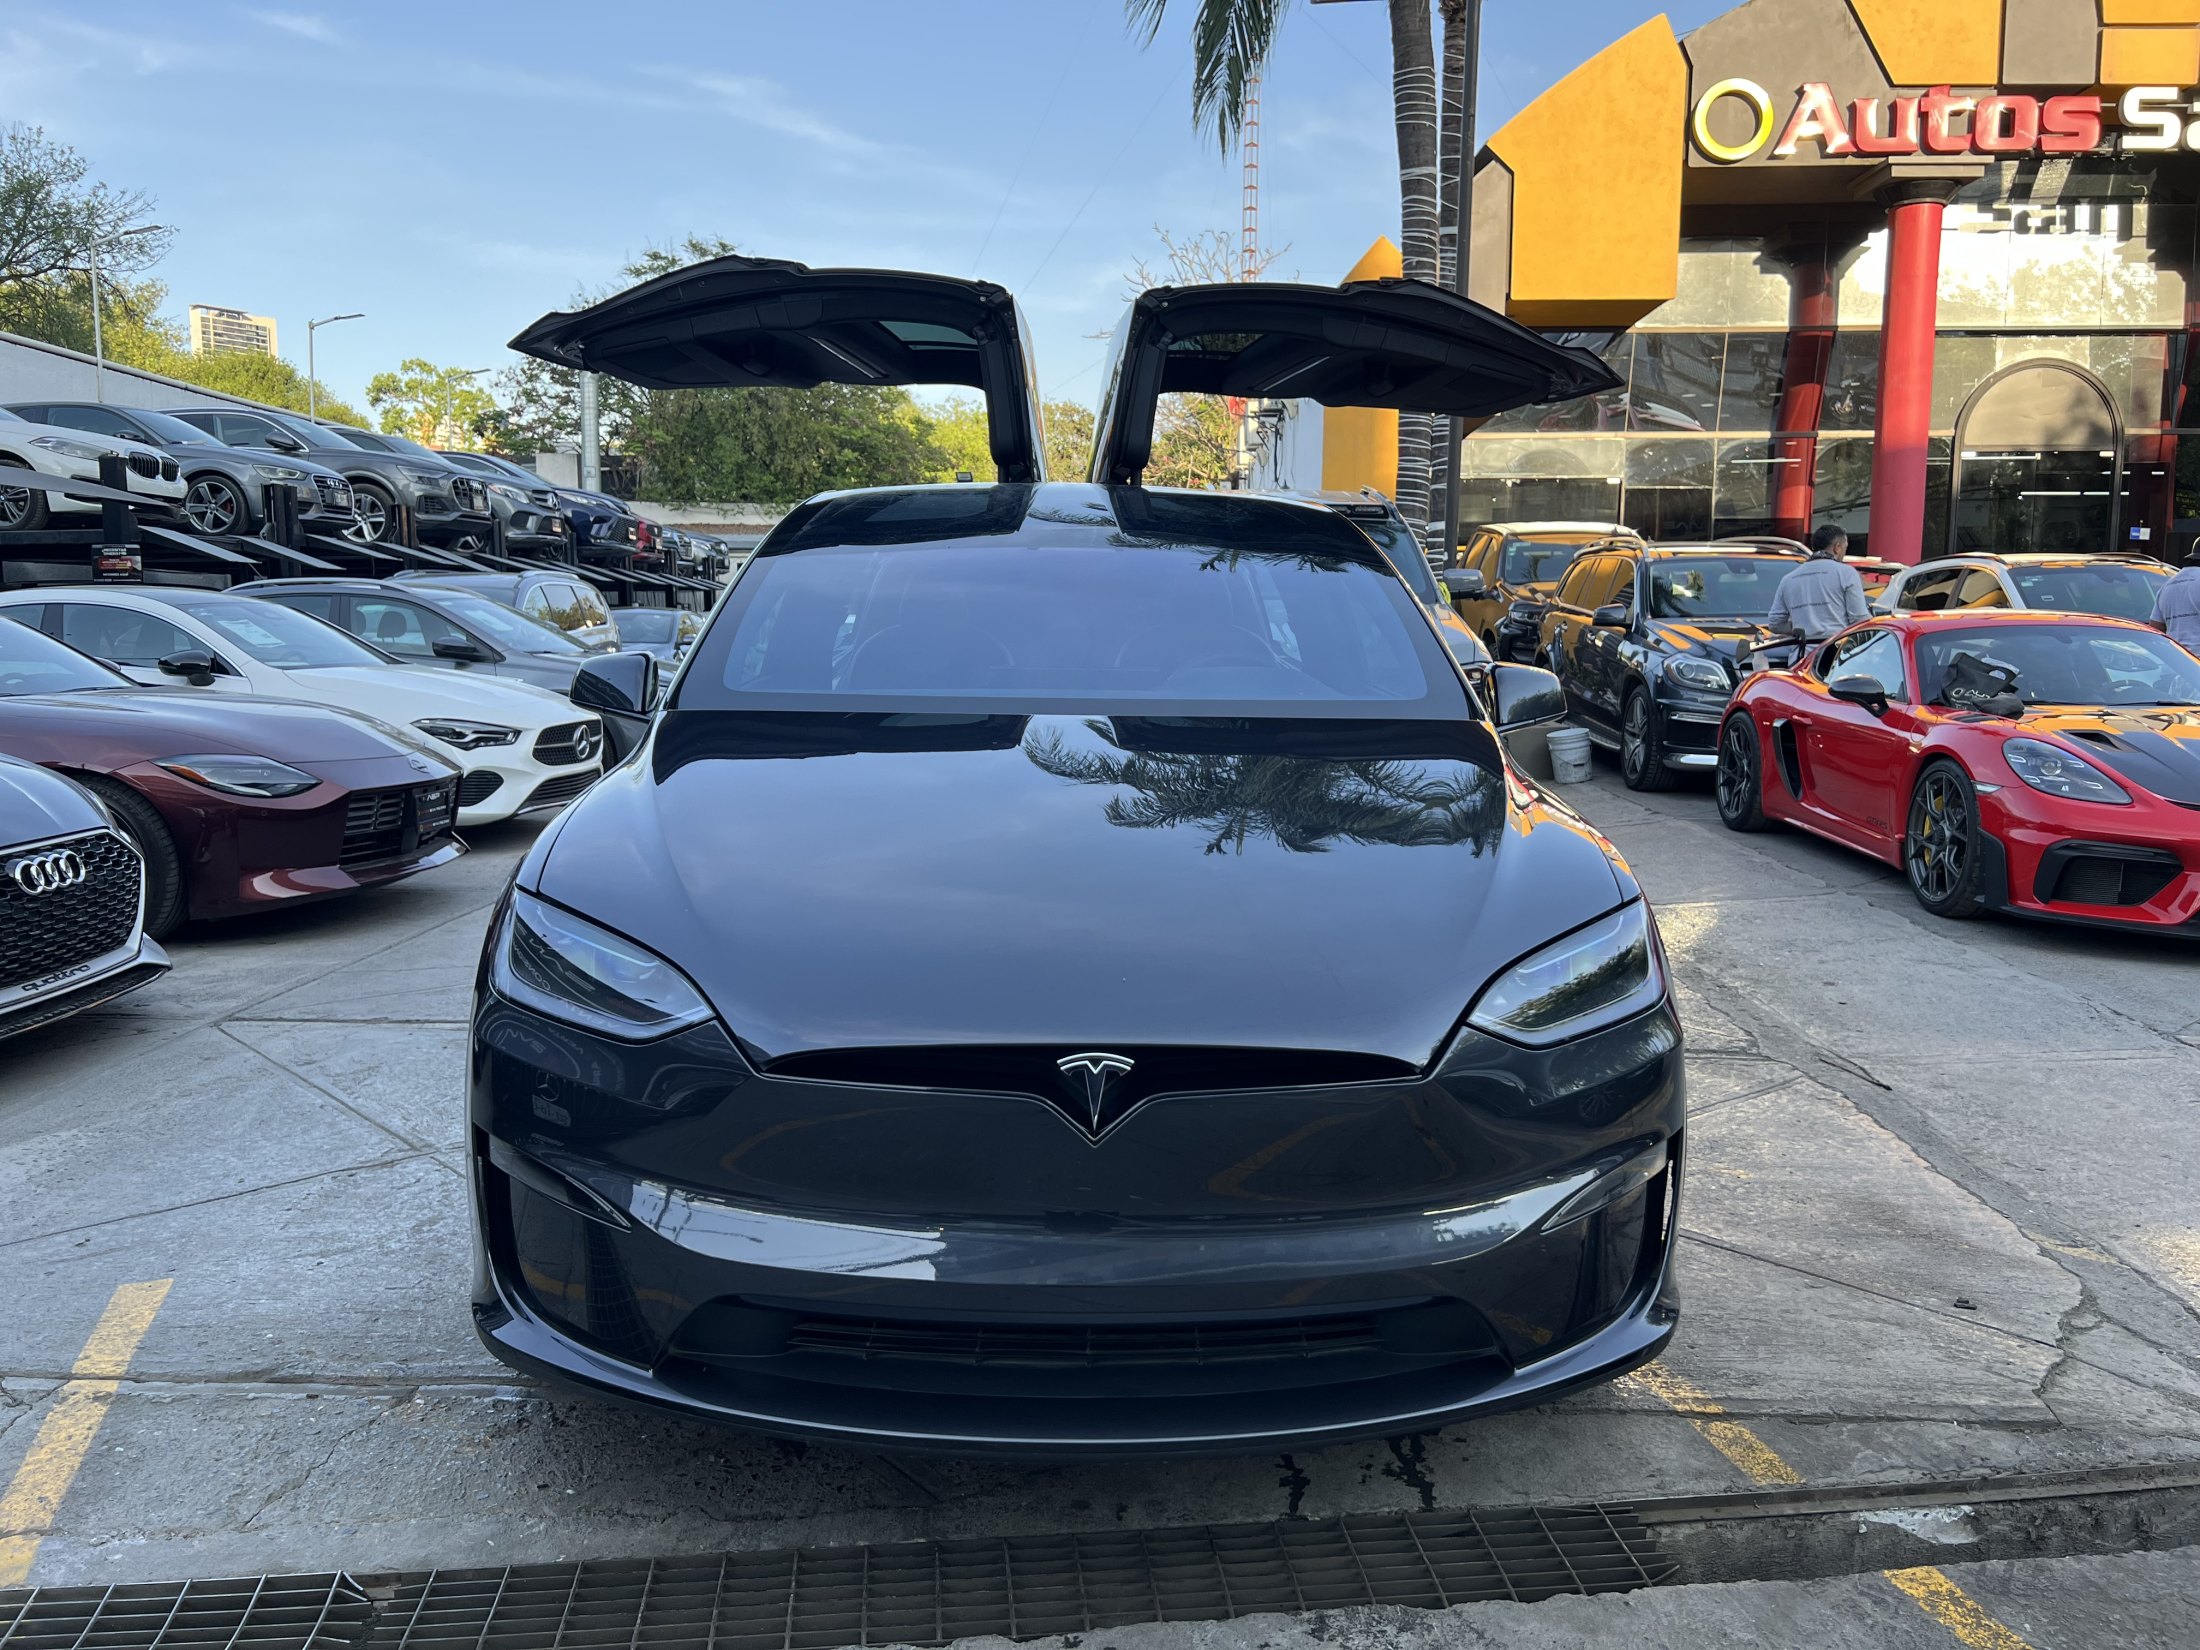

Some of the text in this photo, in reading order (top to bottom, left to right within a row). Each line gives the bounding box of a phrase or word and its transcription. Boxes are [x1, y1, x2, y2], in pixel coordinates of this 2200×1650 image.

[1774, 82, 2200, 154] Autos S
[21, 964, 91, 991] quattro
